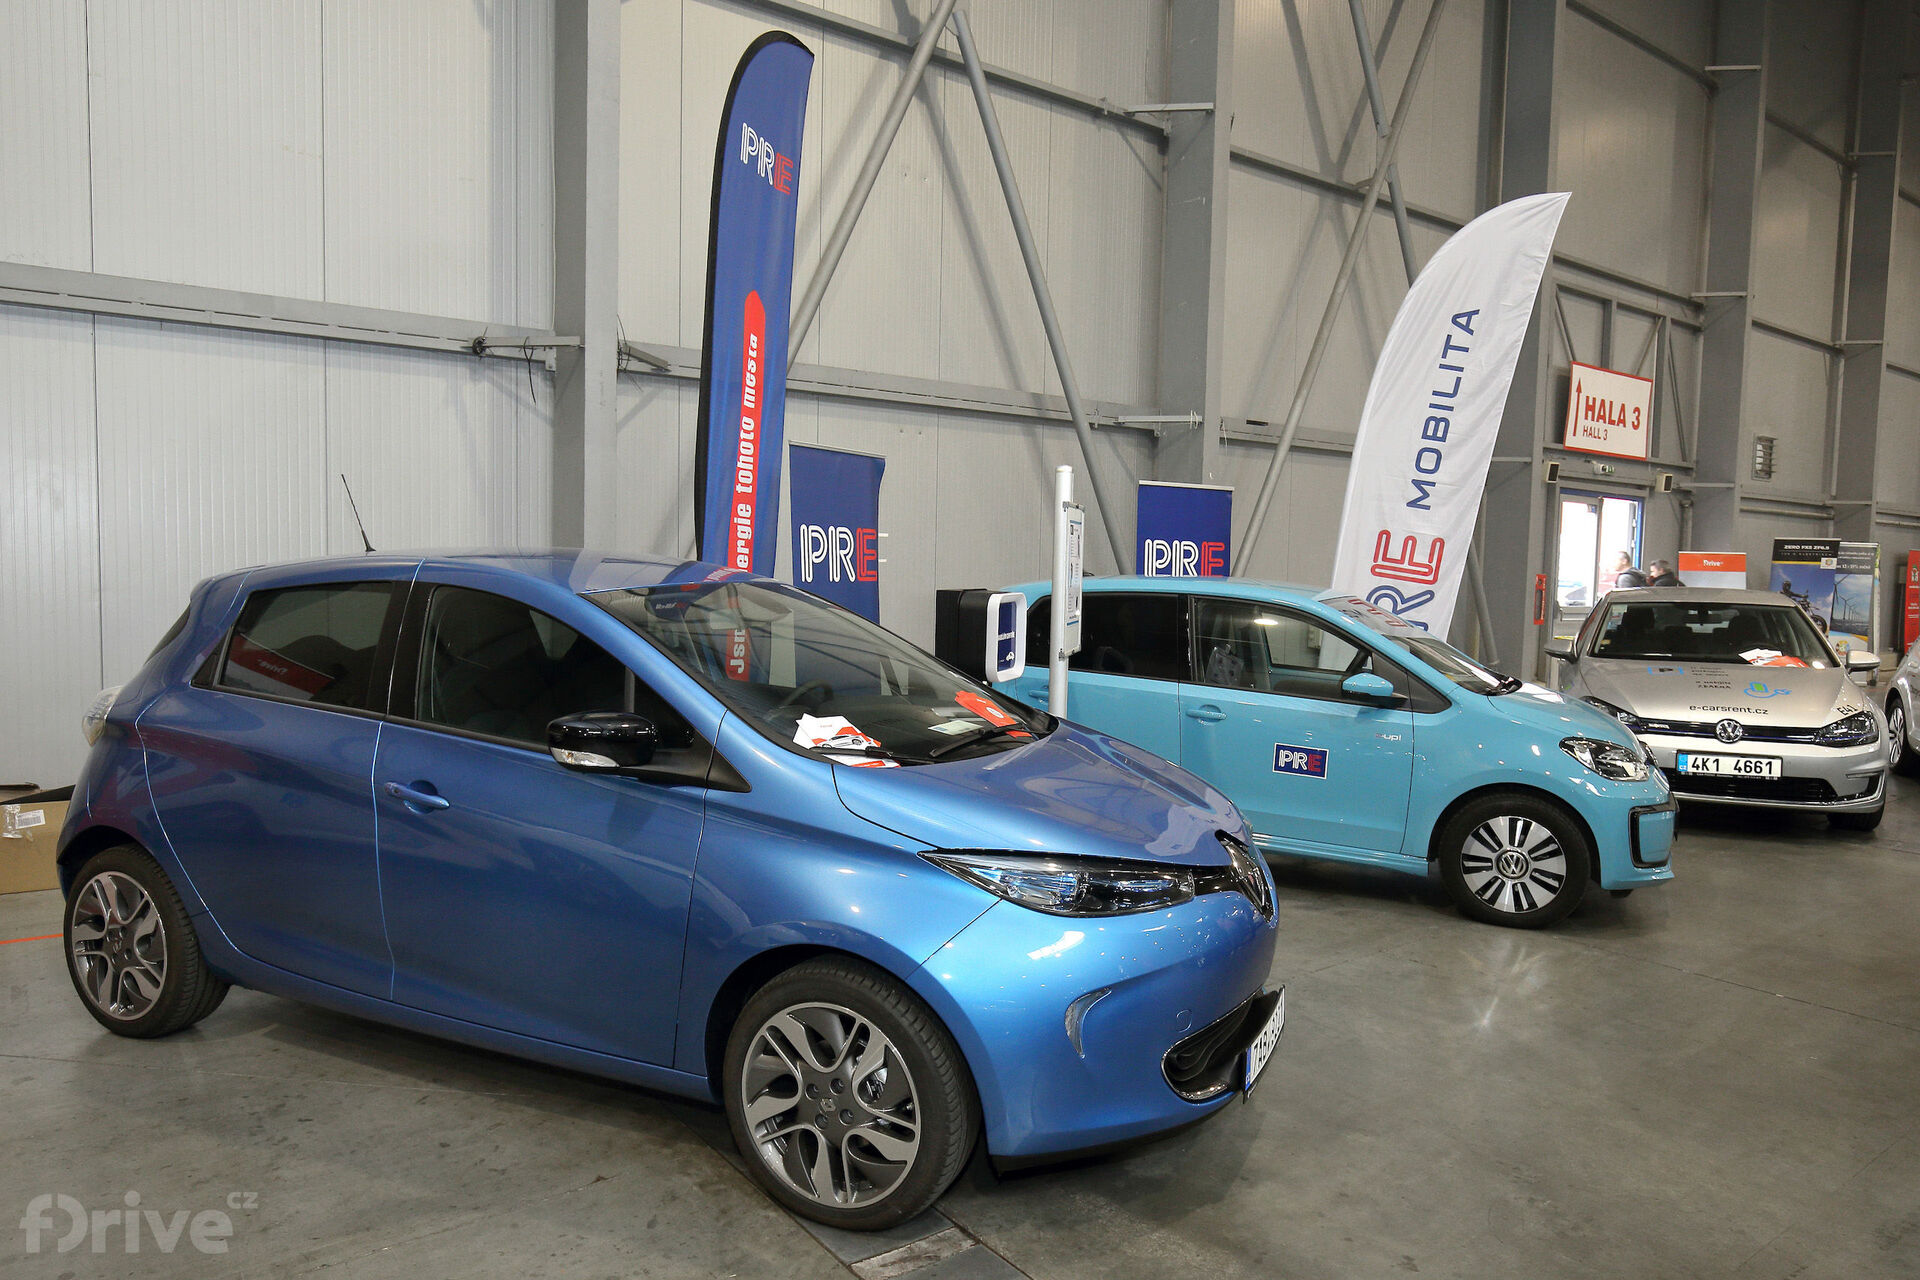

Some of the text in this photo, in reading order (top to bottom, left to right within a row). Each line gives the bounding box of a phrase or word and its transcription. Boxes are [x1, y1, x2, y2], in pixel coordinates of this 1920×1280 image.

[741, 122, 794, 195] PRE
[1406, 308, 1481, 511] MOBILITA
[1584, 395, 1641, 431] HALA 3
[1582, 424, 1608, 441] HALL 3
[736, 416, 755, 494] tohoto
[800, 523, 879, 583] PRE
[1144, 538, 1226, 577] PRE
[1366, 529, 1445, 632] RE
[1689, 703, 1769, 715] e-carsrent.cz
[1836, 703, 1858, 716] E41
[1278, 749, 1322, 772] PRE
[1691, 756, 1720, 772] 4K1
[1733, 758, 1773, 775] 4661
